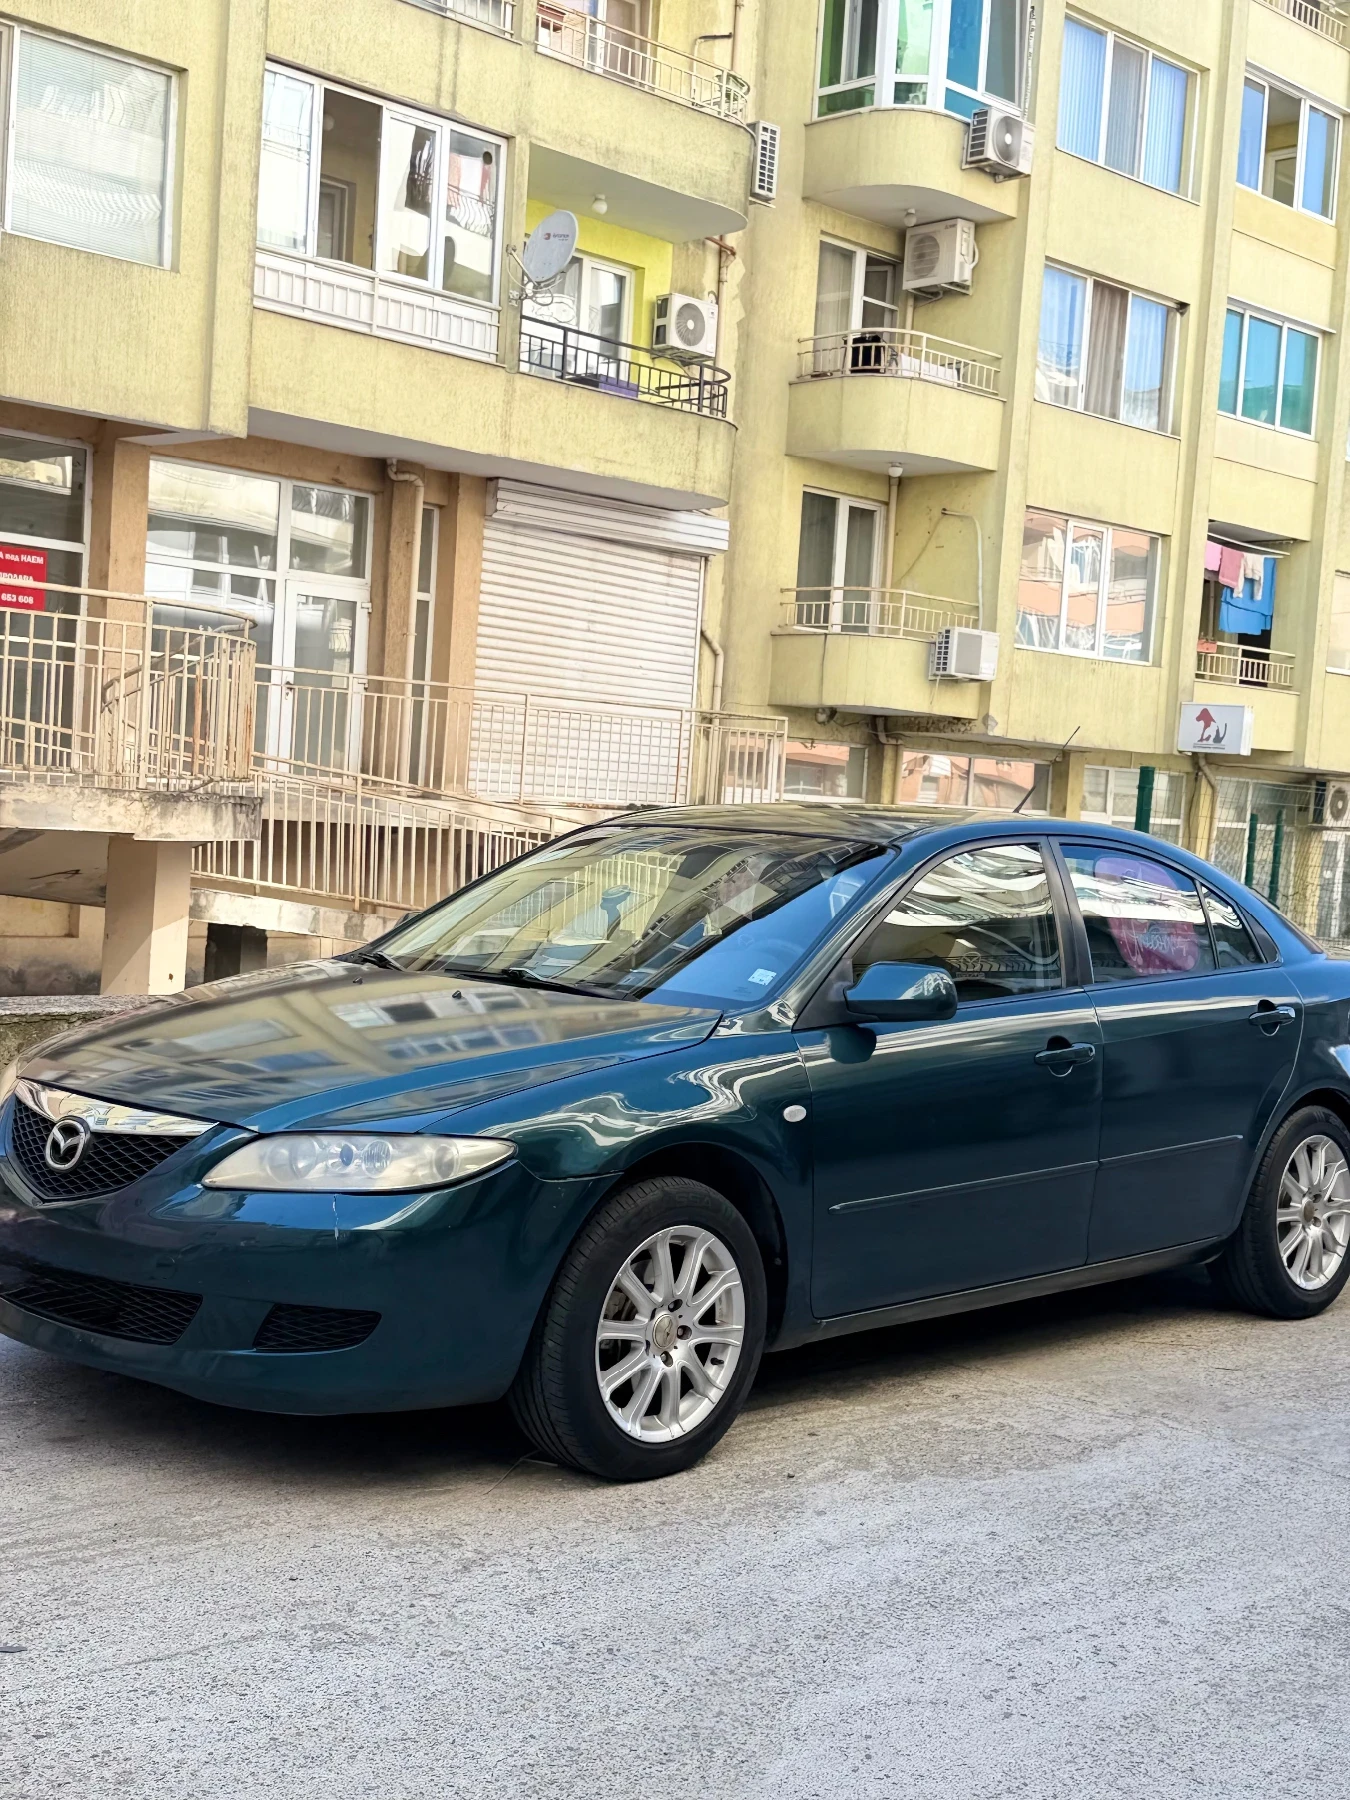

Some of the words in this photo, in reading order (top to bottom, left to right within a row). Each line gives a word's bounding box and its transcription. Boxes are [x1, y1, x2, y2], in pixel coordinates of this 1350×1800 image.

[21, 554, 44, 564] НАЕМ
[1, 593, 17, 602] 653
[18, 595, 34, 604] 608
